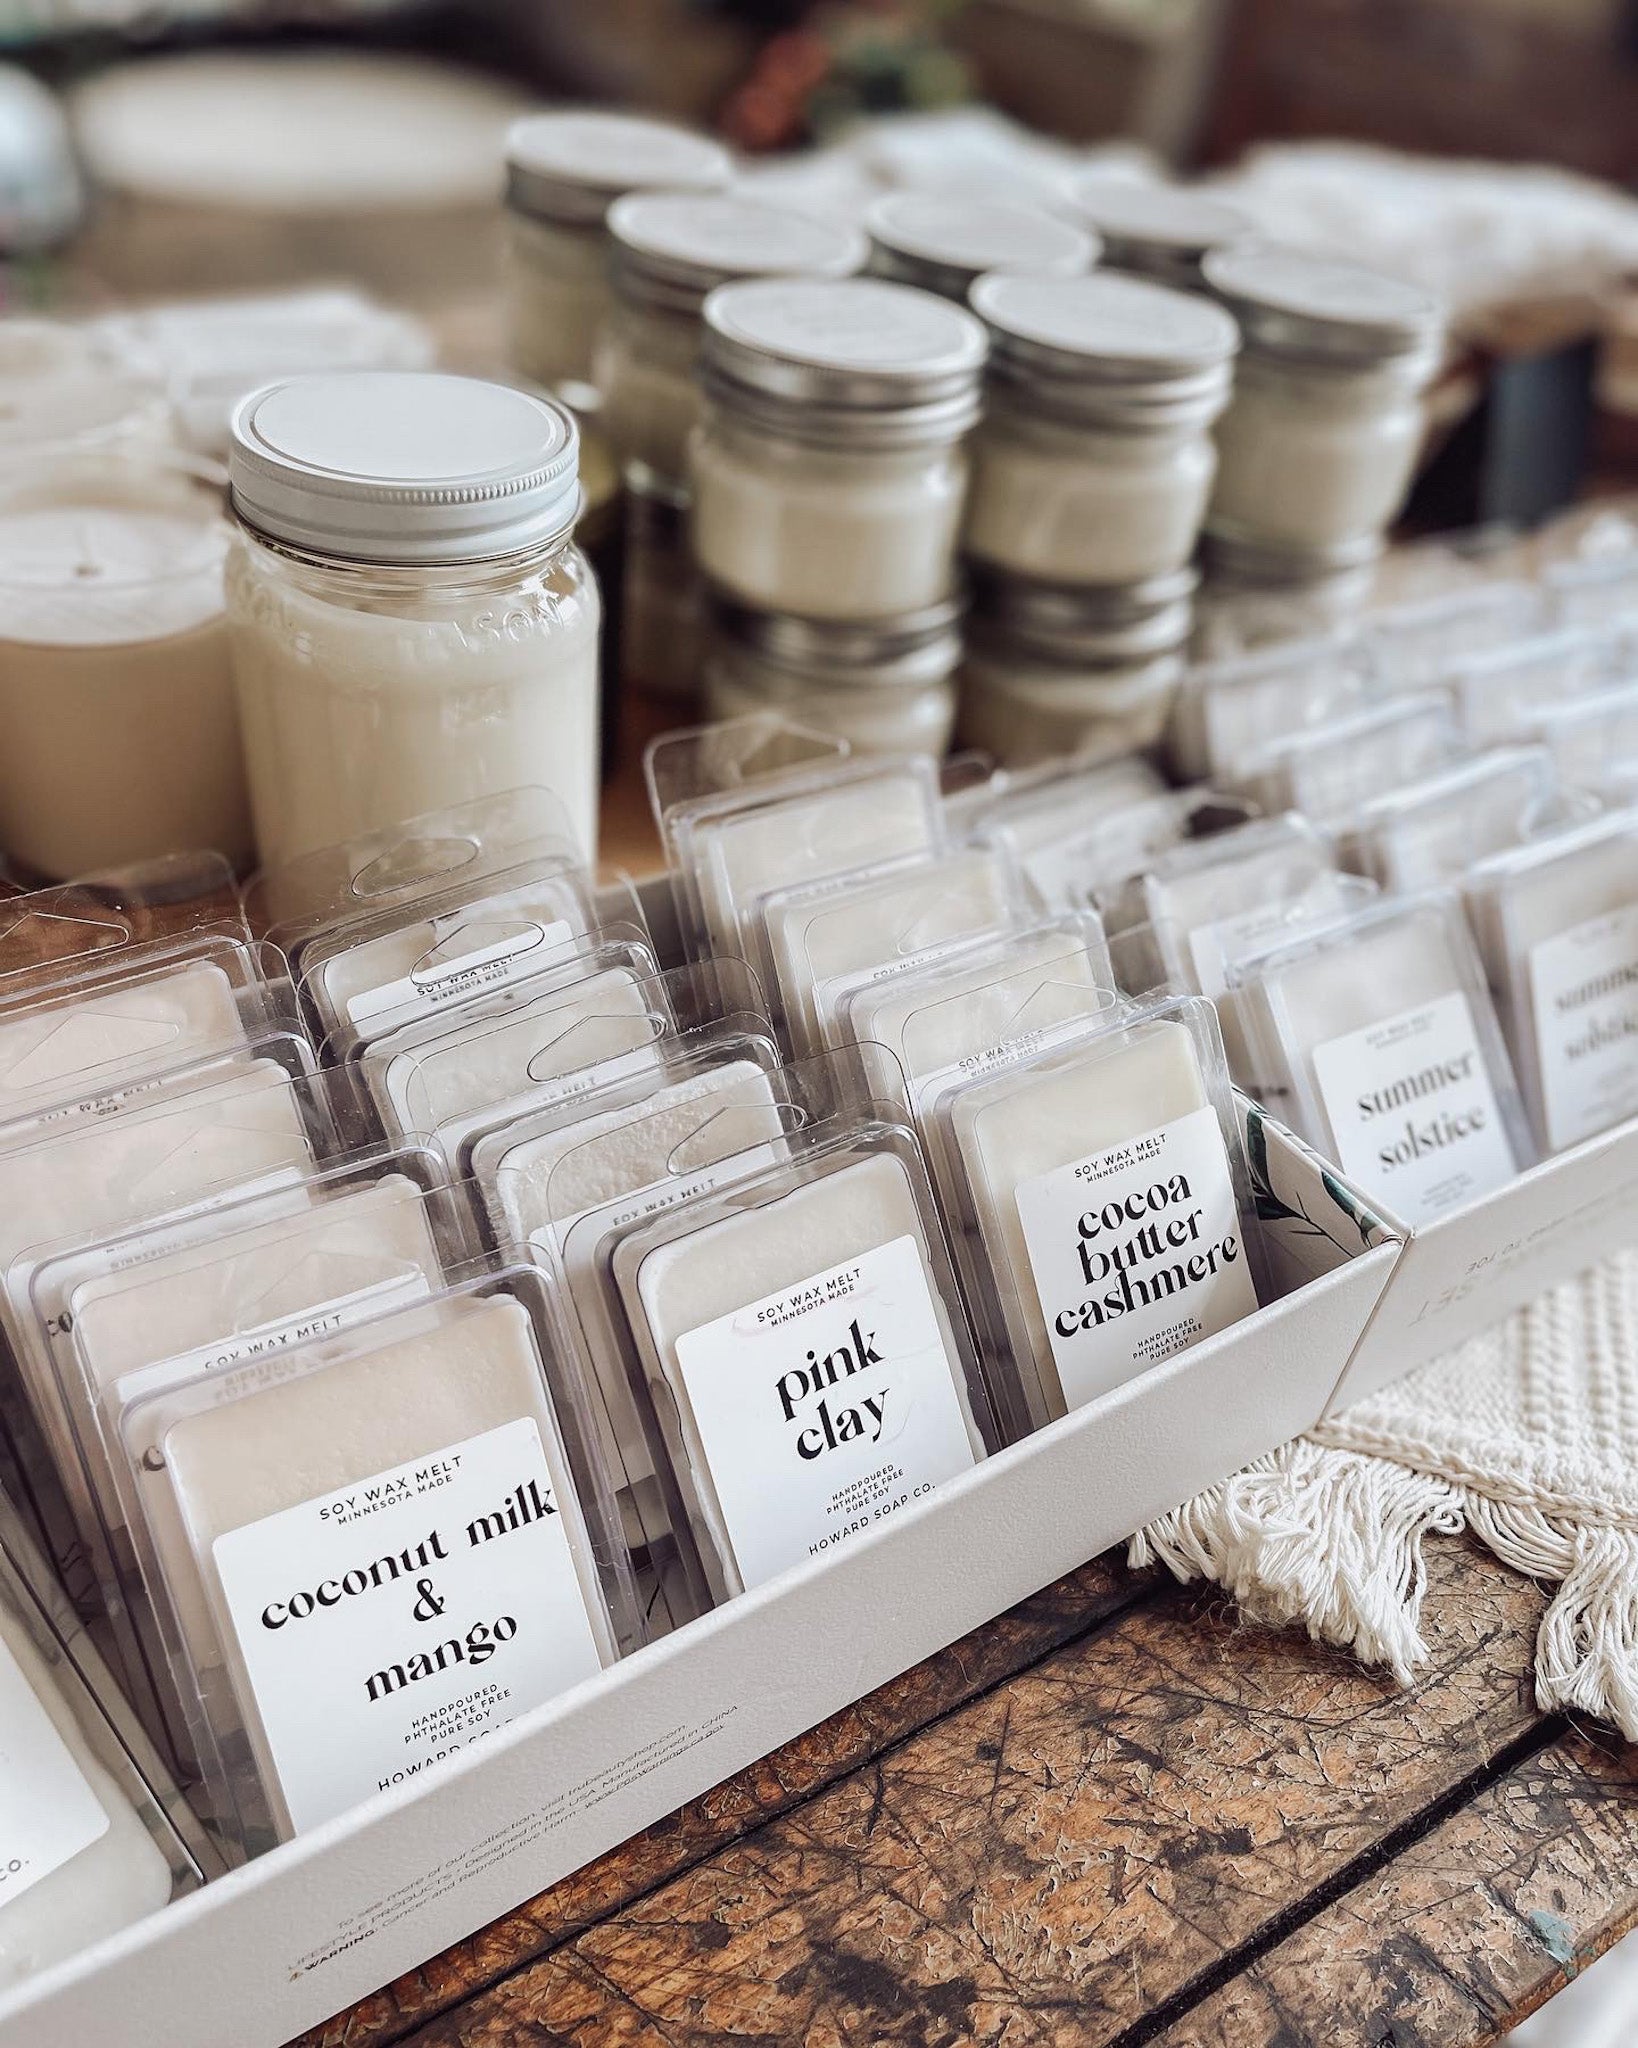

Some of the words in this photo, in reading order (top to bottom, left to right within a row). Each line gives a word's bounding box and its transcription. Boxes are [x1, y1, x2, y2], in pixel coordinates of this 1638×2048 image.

[1358, 1052, 1474, 1121] summer
[1074, 1161, 1099, 1178] SOY
[1103, 1149, 1131, 1166] WAX
[1136, 1133, 1168, 1153] MELT
[1087, 1159, 1135, 1183] MINNESOTA
[1138, 1148, 1162, 1162] MADE
[1380, 1109, 1486, 1173] solstice
[1077, 1174, 1193, 1239] cocoa
[1076, 1209, 1203, 1285] butter
[757, 1303, 785, 1323] SOY
[789, 1286, 822, 1307] WAX
[826, 1268, 862, 1291] MELT
[771, 1298, 826, 1327] MINNESOTA
[828, 1284, 855, 1301] MADE
[1055, 1236, 1238, 1338] cashmere
[1132, 1335, 1181, 1360] PHTHALATE
[1182, 1322, 1203, 1337] FREE
[1137, 1318, 1196, 1348] HANDPOURED
[1149, 1346, 1171, 1360] PURE
[1173, 1336, 1191, 1350] SOY
[775, 1318, 886, 1422] pink
[797, 1388, 890, 1460] clay
[319, 1496, 357, 1520] SOY
[365, 1477, 408, 1500] WAX
[415, 1455, 462, 1483] MELT
[337, 1491, 412, 1525] MINNESOTA
[417, 1474, 453, 1493] MADE
[826, 1482, 879, 1515] PHTHALATE
[882, 1468, 904, 1485] FREE
[831, 1464, 894, 1502] HANDPOURED
[846, 1499, 870, 1514] PURE
[873, 1486, 890, 1500] SOY
[809, 1516, 869, 1556] HOWARD
[874, 1494, 909, 1520] SOAP
[913, 1482, 937, 1498] CO.
[262, 1530, 449, 1629] coconut
[465, 1479, 558, 1547] milk
[413, 1578, 447, 1622] &
[364, 1616, 517, 1702] mango
[404, 1705, 477, 1744] PHTHALATE
[481, 1689, 511, 1709] FREE
[412, 1684, 498, 1729] HANDPOURED
[430, 1724, 464, 1743] PURE
[468, 1709, 492, 1727] SOY
[371, 1873, 453, 1923] PRODUCTS
[465, 1828, 527, 1869] Designed
[545, 1807, 565, 1821] the
[602, 1736, 685, 1788] Manufactured
[702, 1705, 738, 1729] CHINA
[387, 1877, 424, 1901] more
[428, 1865, 441, 1878] of
[445, 1853, 466, 1868] our
[541, 1794, 564, 1811] visit
[382, 1899, 428, 1927] Cancer
[432, 1881, 455, 1899] and
[459, 1832, 541, 1883] Reproductive
